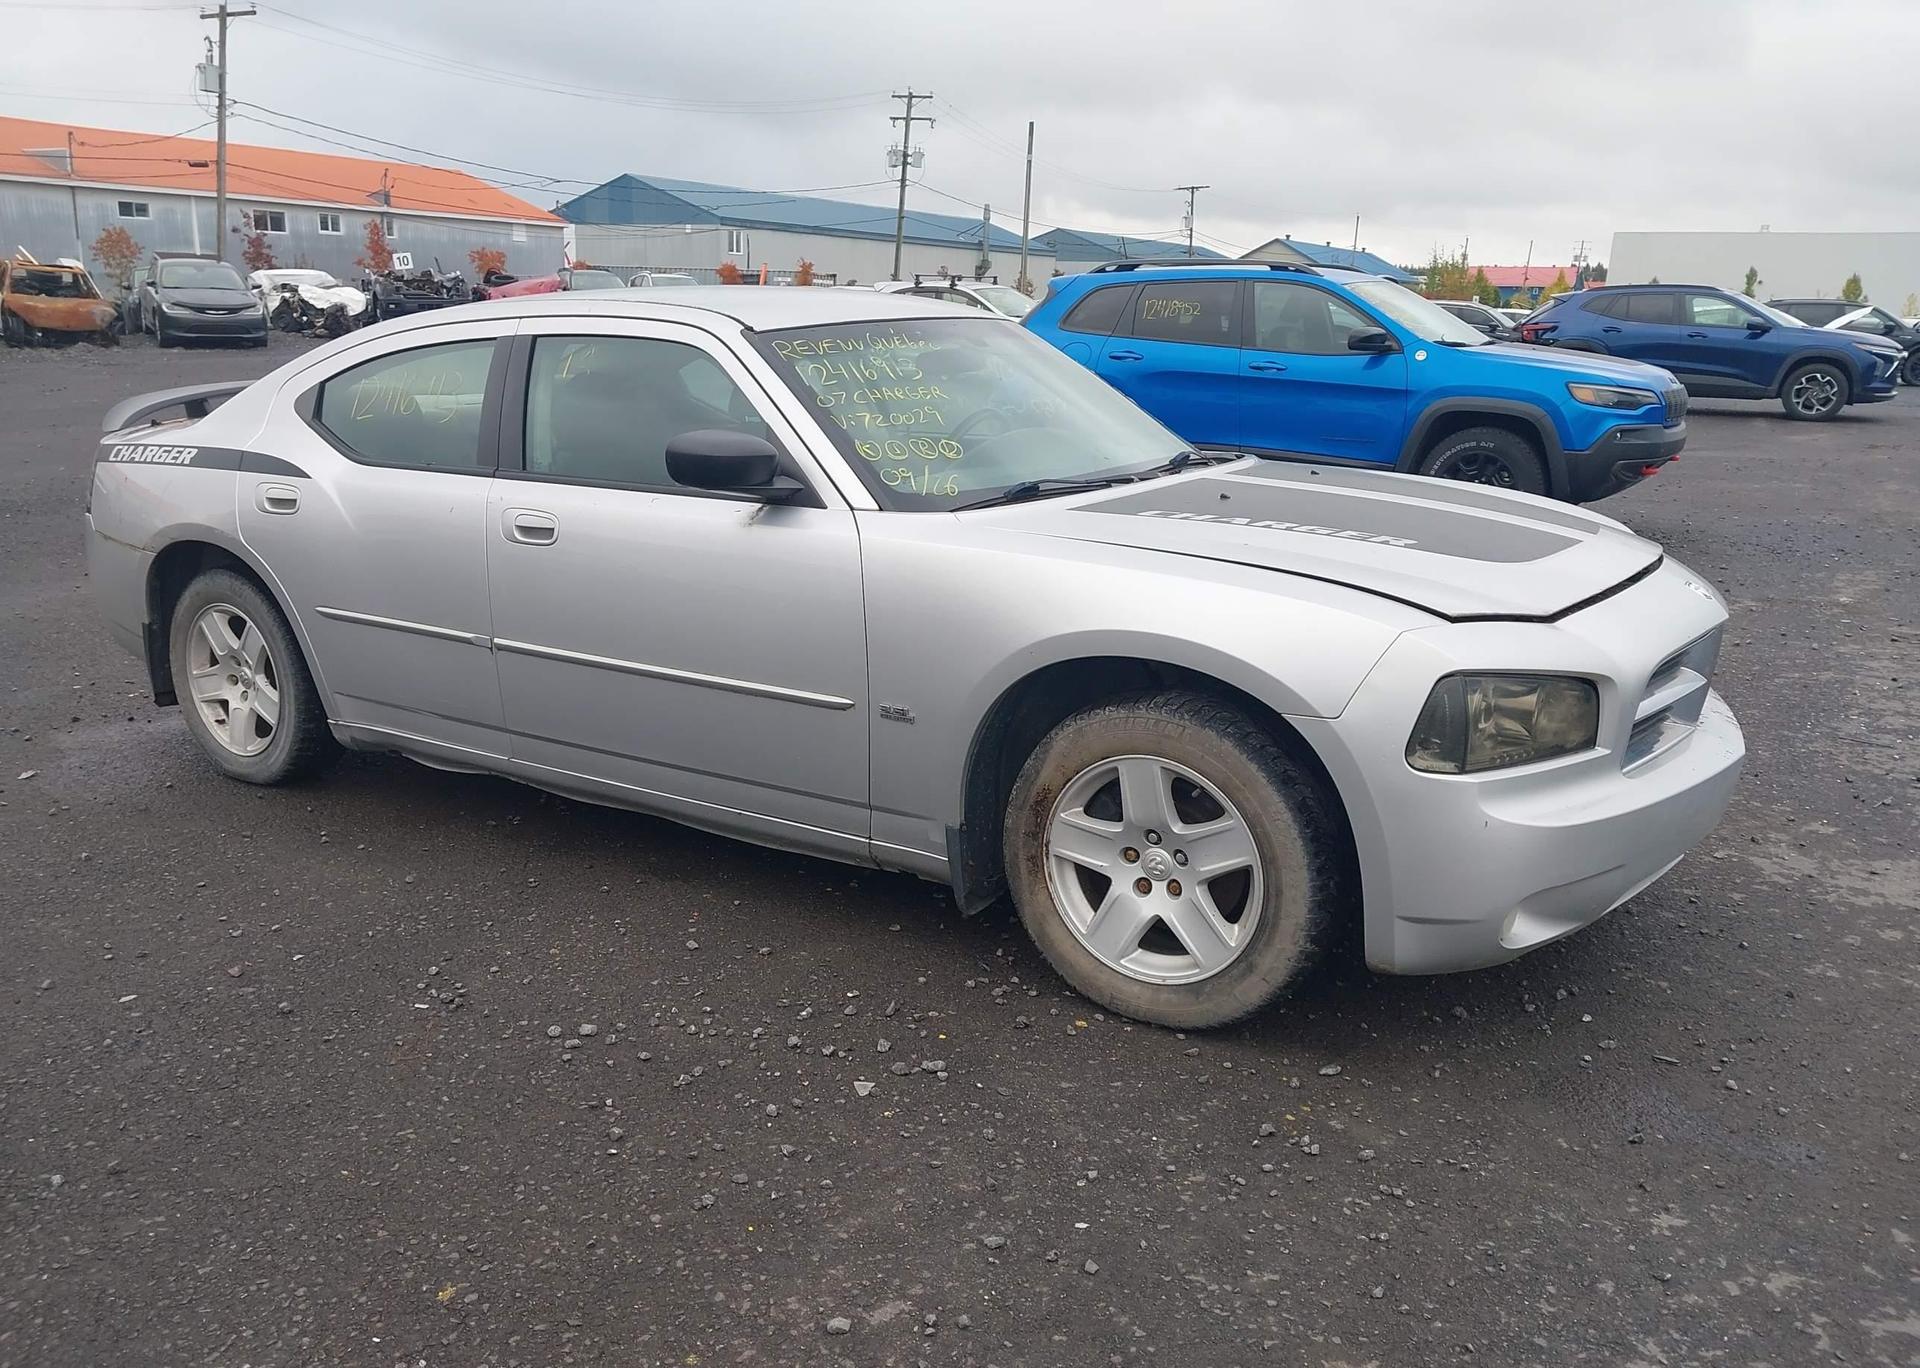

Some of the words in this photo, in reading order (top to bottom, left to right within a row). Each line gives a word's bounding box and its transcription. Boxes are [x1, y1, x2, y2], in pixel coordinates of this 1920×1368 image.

[396, 255, 410, 267] 10
[1142, 299, 1201, 320] 12418952
[817, 392, 847, 408] 07
[853, 386, 949, 404] CHARGER
[108, 445, 198, 465] CHARGER
[1137, 510, 1418, 547] CHARGER
